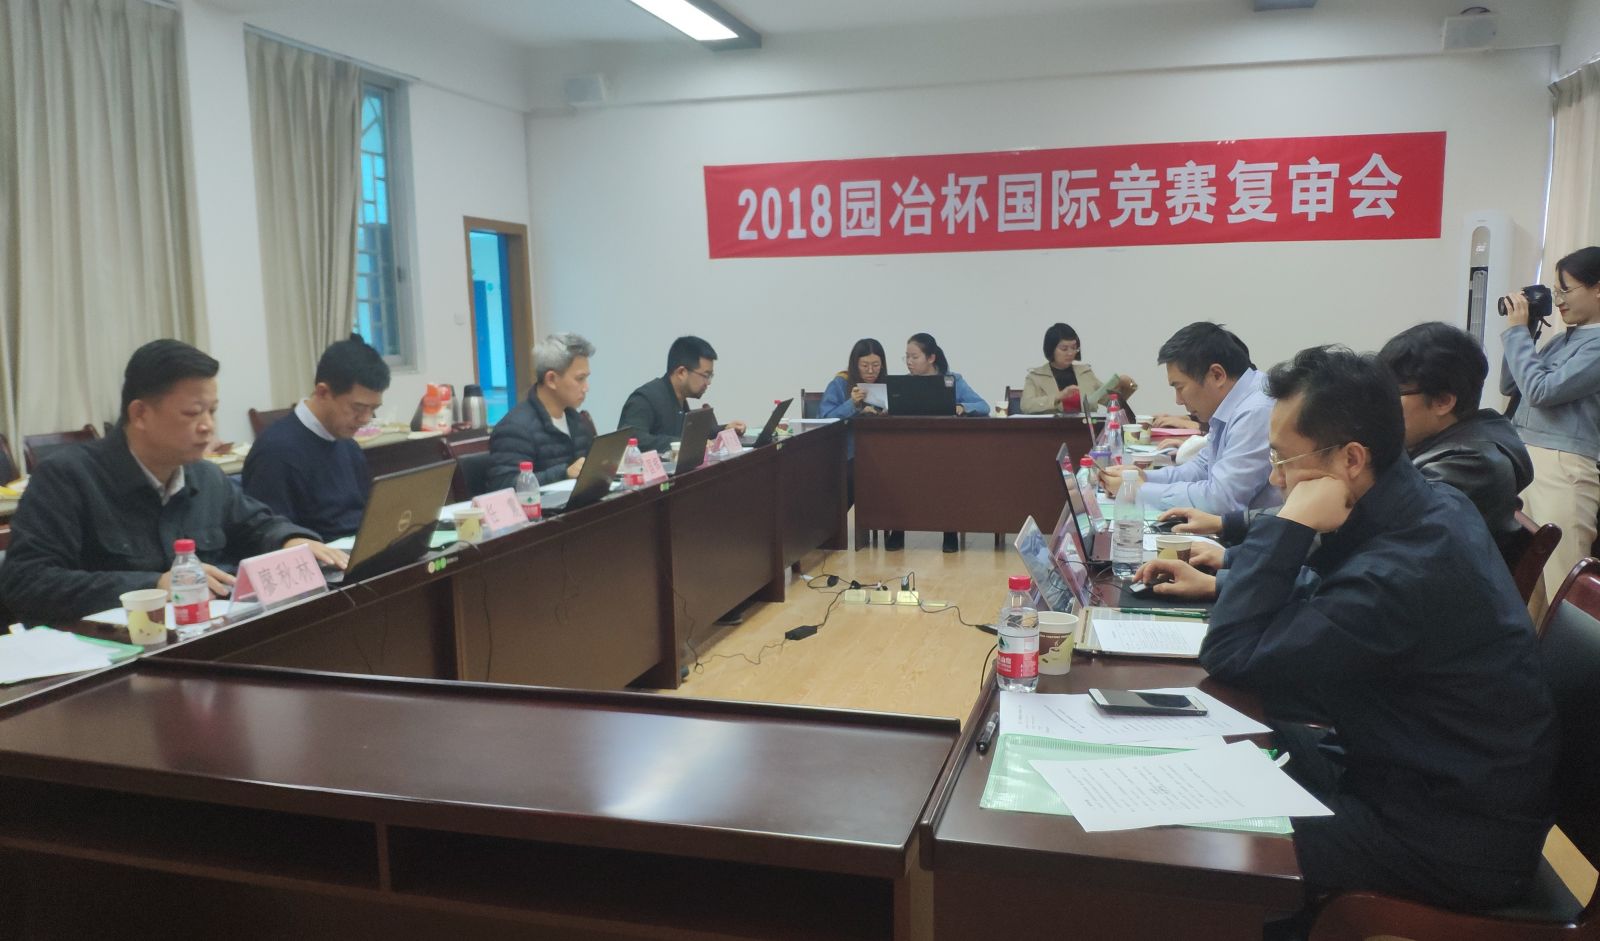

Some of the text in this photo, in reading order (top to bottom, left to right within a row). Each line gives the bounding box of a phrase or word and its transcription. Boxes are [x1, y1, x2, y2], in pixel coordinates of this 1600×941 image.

[738, 153, 1403, 241] 2018园冶杯国际竞赛复审会
